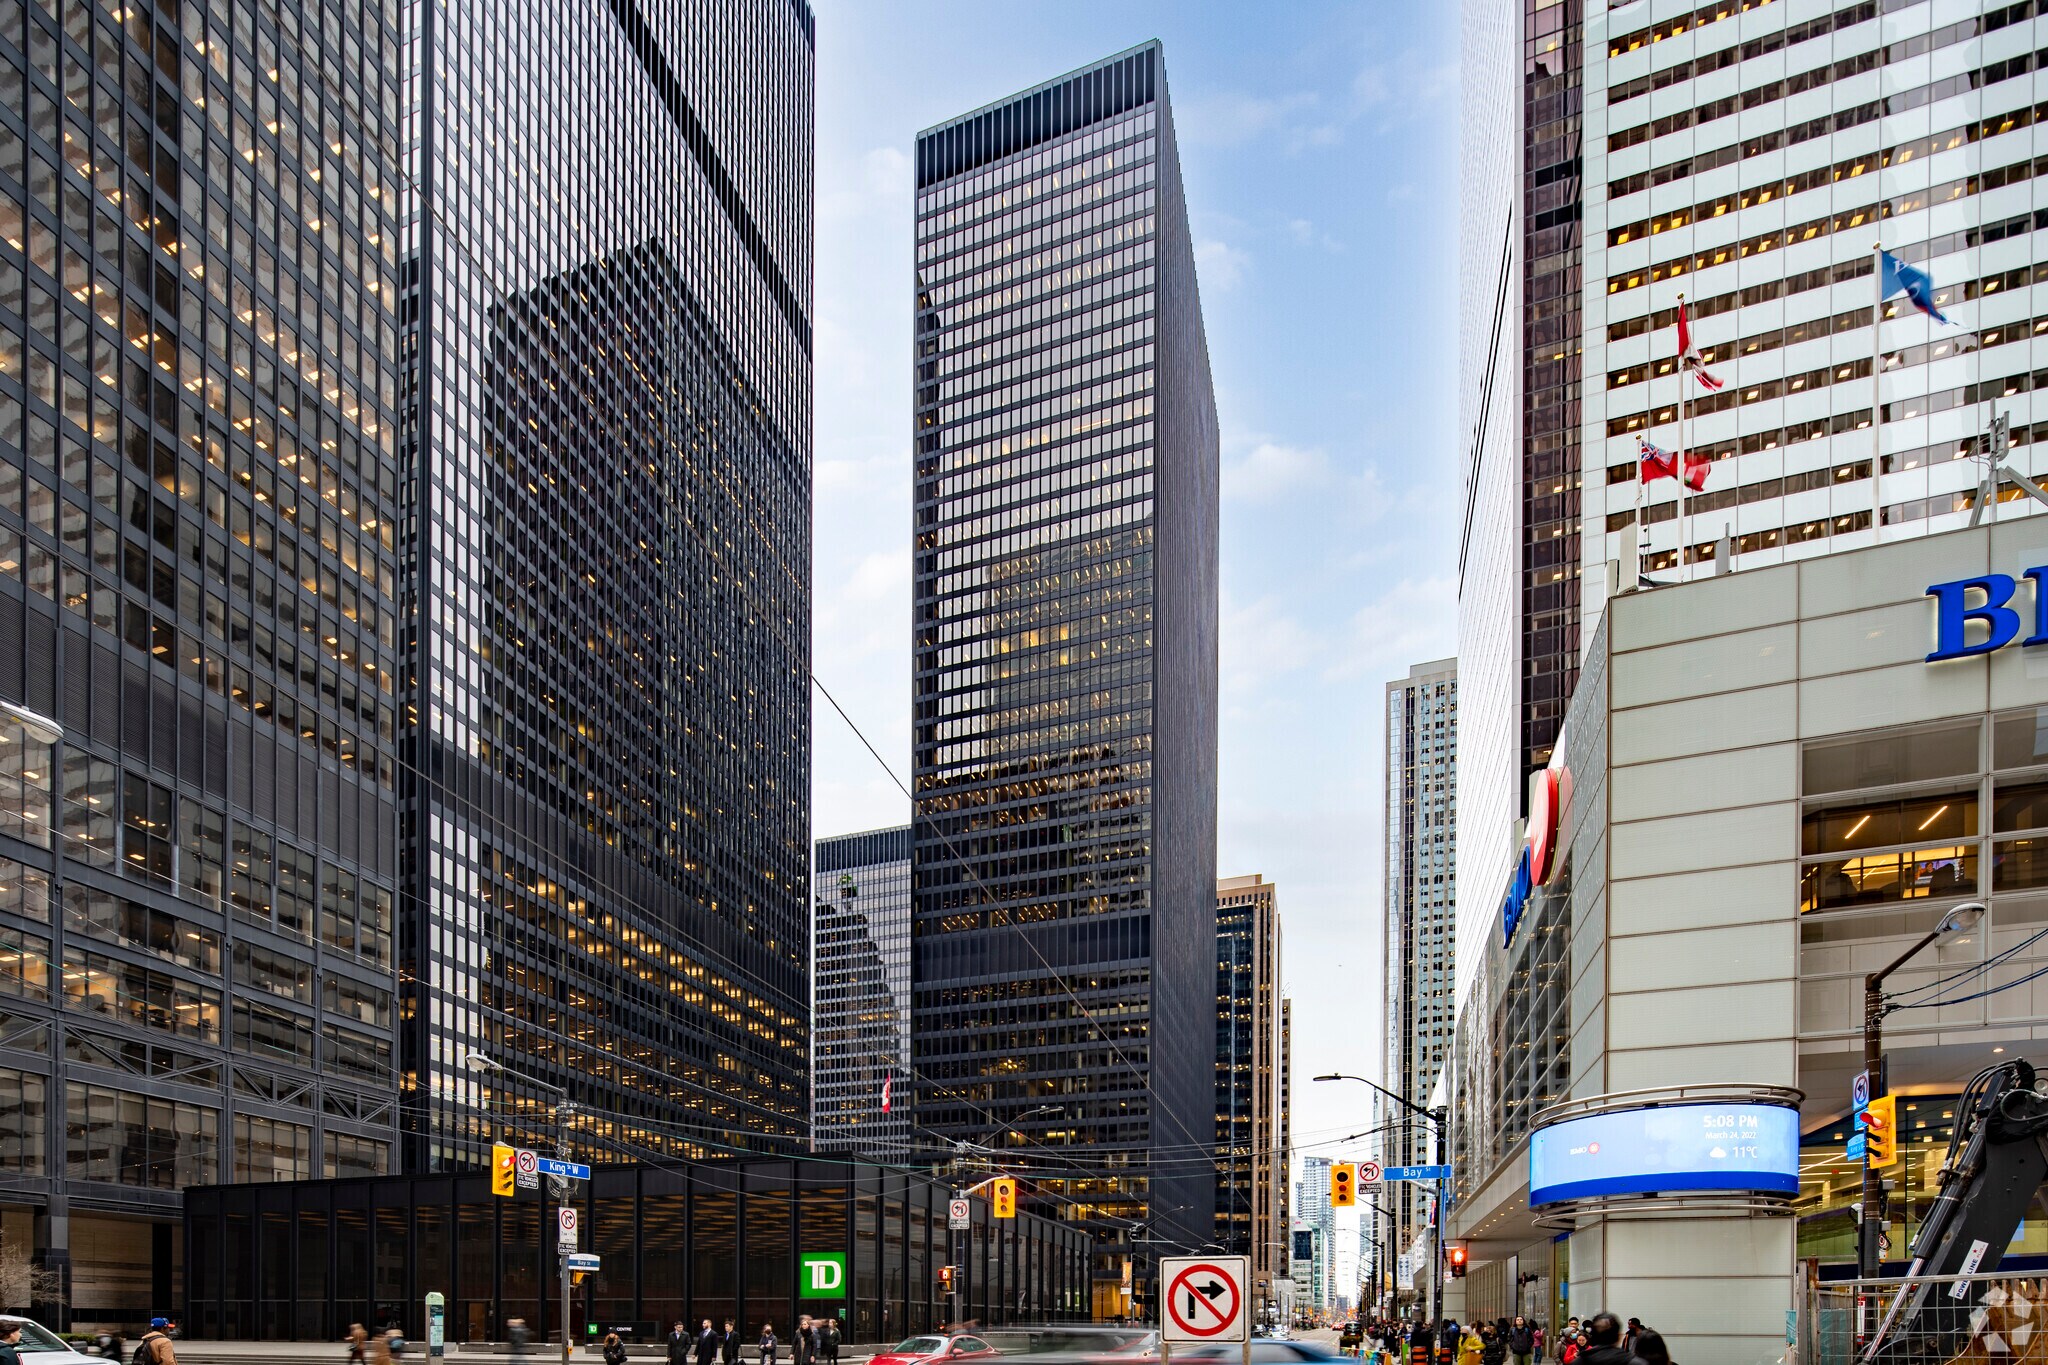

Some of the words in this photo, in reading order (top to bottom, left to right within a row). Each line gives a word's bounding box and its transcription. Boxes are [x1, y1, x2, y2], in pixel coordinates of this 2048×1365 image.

[1703, 1114, 1735, 1128] 5:08
[1738, 1115, 1758, 1128] PM
[1705, 1131, 1728, 1140] March
[1729, 1131, 1740, 1140] 24,
[1741, 1131, 1757, 1139] 2022
[549, 1161, 566, 1175] King
[571, 1165, 579, 1175] W
[1403, 1168, 1422, 1178] Bay
[804, 1260, 842, 1289] TD
